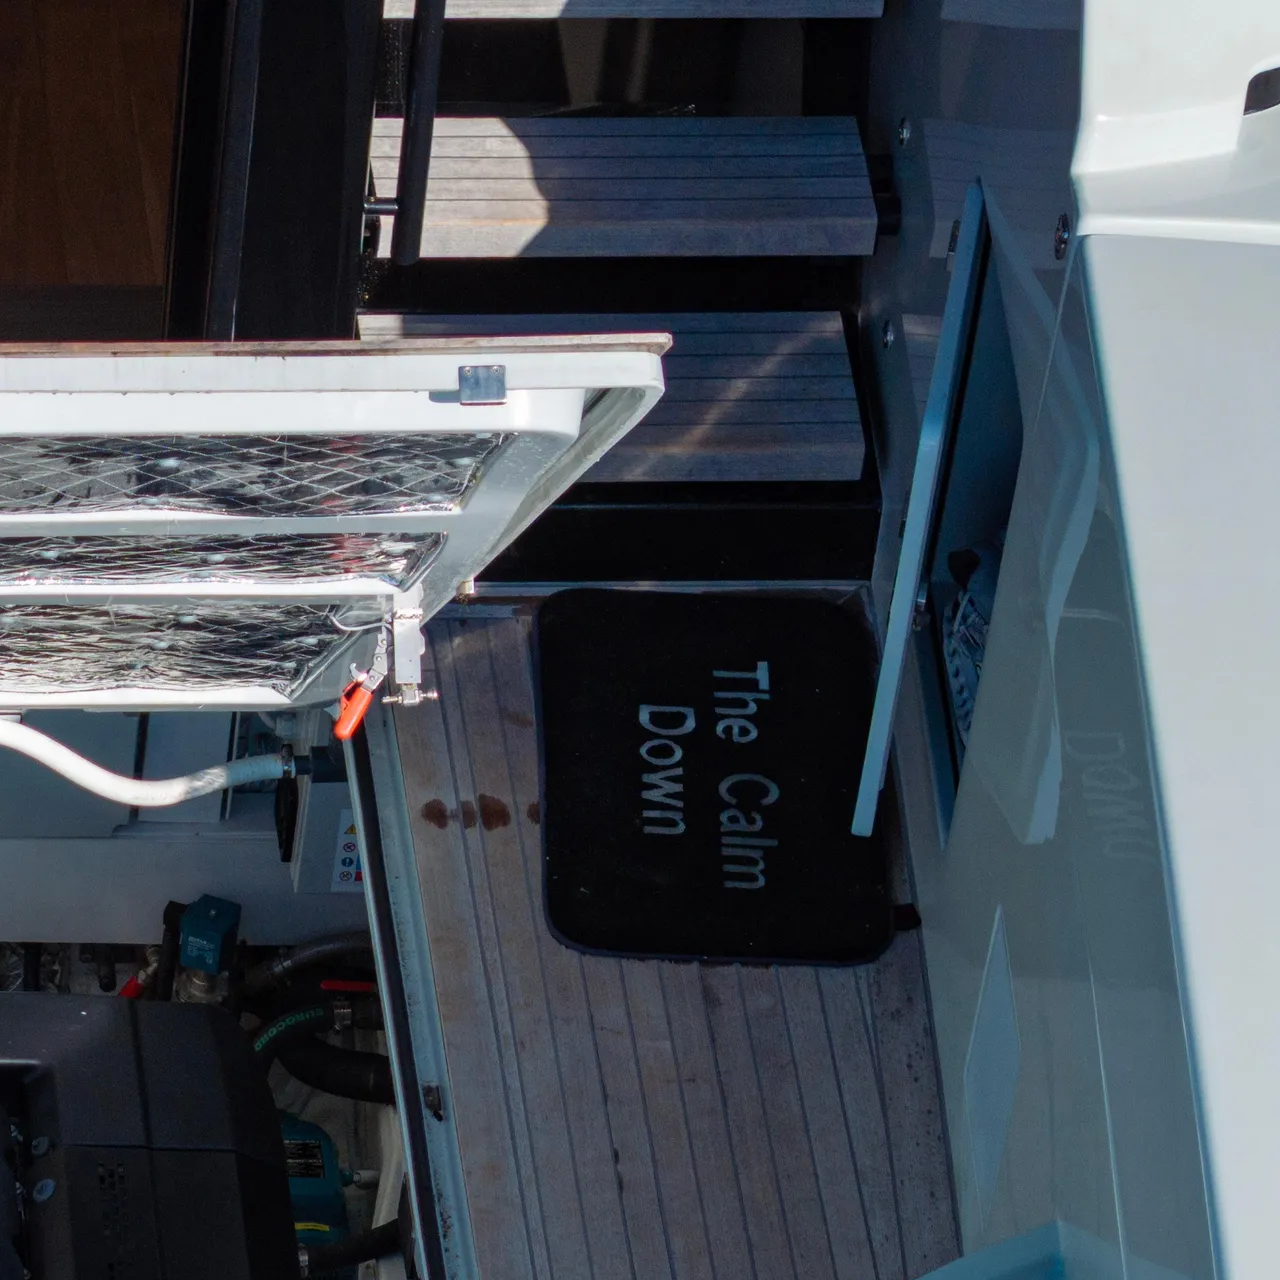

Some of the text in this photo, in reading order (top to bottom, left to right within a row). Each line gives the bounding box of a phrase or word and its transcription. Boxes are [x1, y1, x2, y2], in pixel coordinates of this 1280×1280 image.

[637, 703, 697, 836] Down
[711, 660, 781, 890] The Calm
